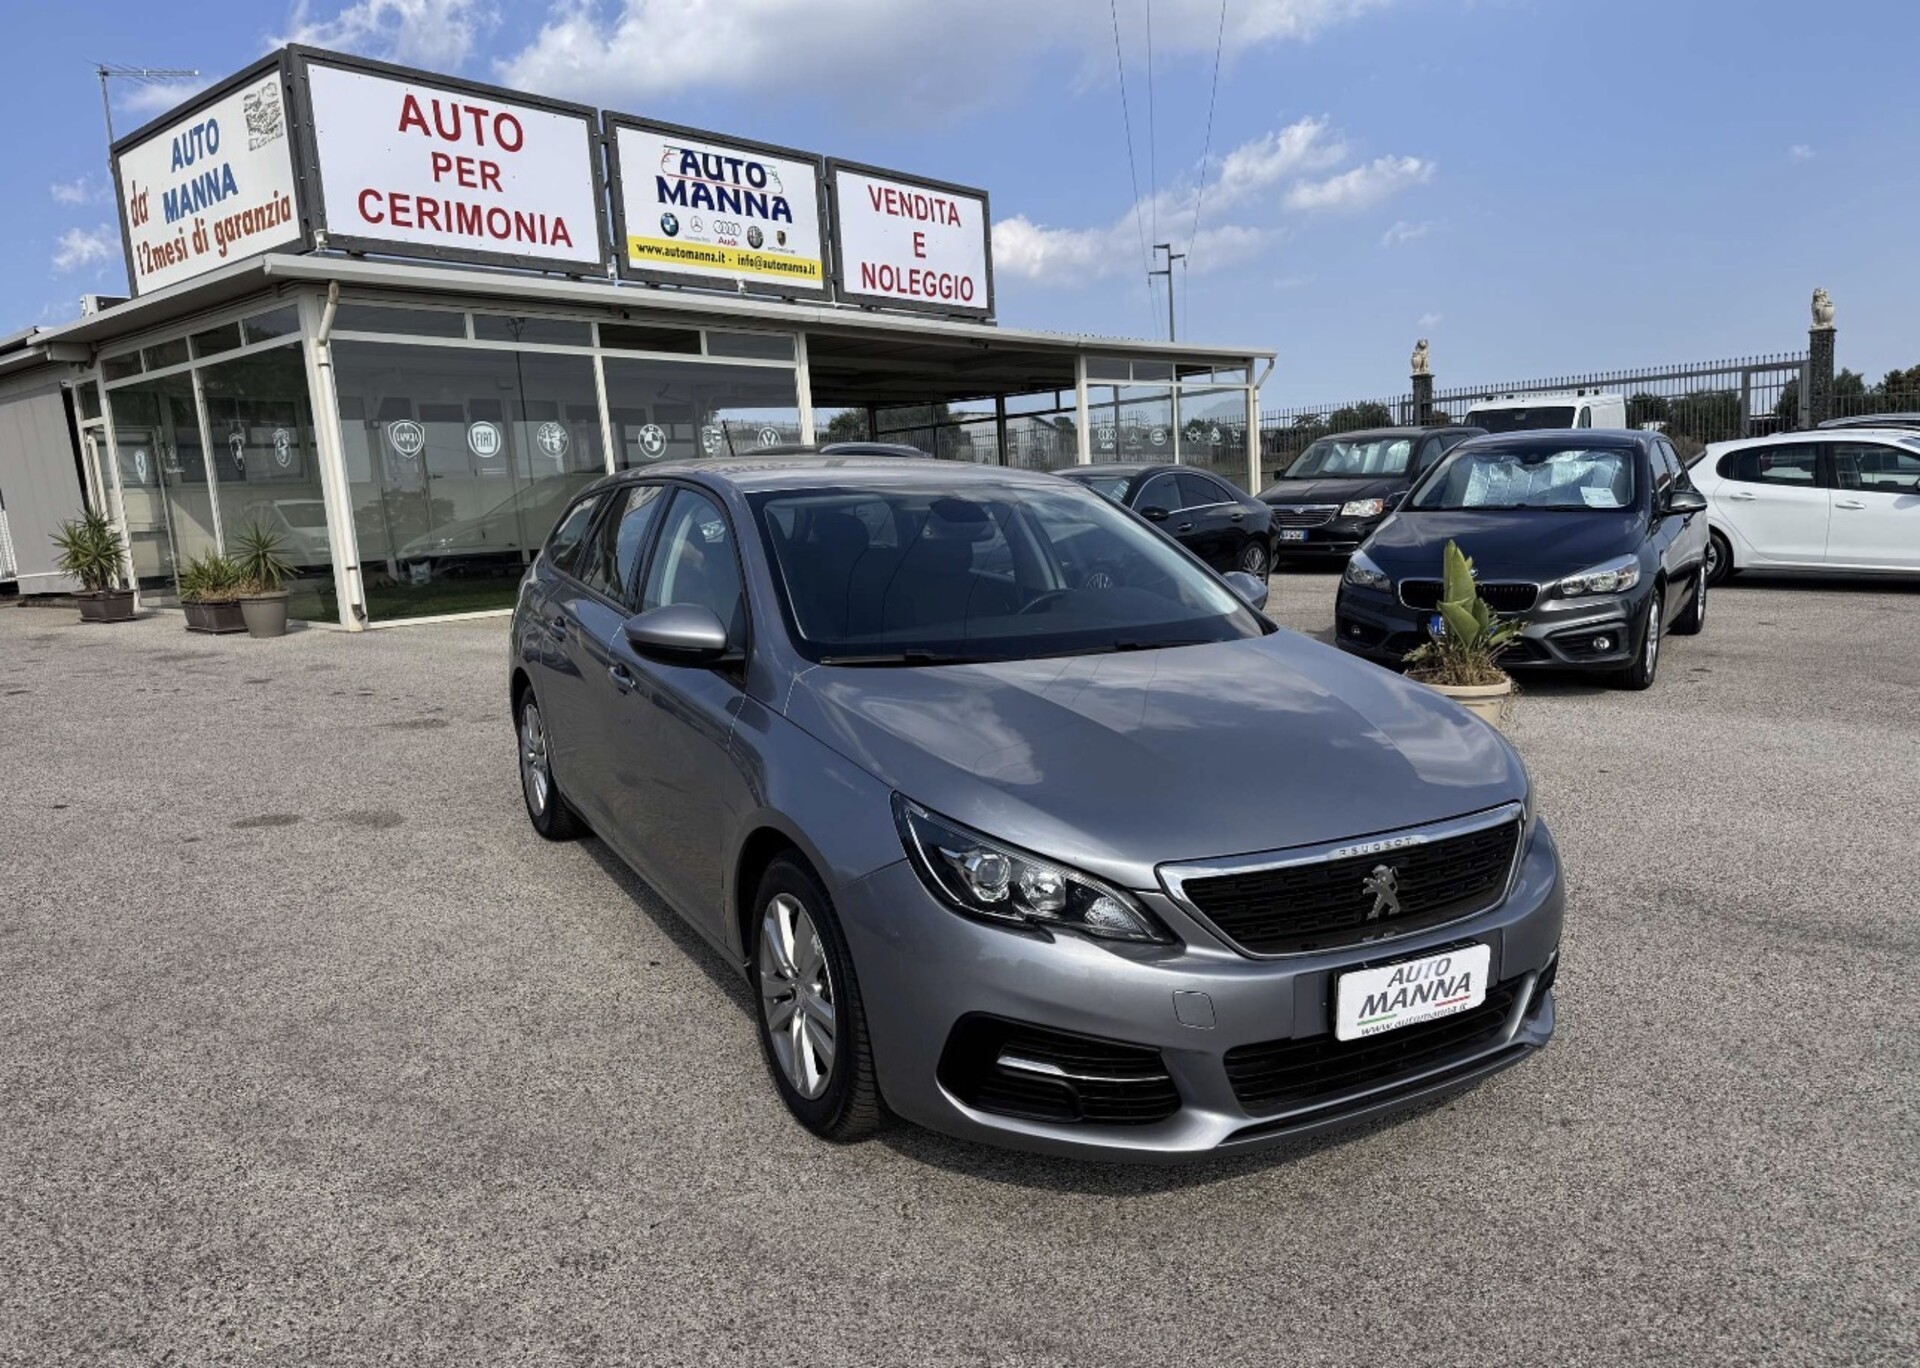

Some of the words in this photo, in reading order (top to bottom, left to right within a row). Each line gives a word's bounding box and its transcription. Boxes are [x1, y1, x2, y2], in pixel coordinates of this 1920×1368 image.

[398, 94, 524, 153] AUTO
[171, 118, 219, 173] AUTO
[431, 151, 504, 192] PER
[679, 148, 767, 189] AUTO
[162, 162, 239, 224] MANNA
[655, 175, 793, 224] MANNA
[867, 184, 962, 228] VENDITA
[192, 217, 210, 255] di
[214, 190, 292, 258] garanzia
[358, 188, 573, 248] CERIMONIA
[637, 242, 726, 264] www.automanna.it
[738, 253, 816, 275] info@automanna.it
[717, 236, 739, 247] Audi
[912, 232, 927, 258] E
[861, 262, 974, 302] NOLEGGIO
[475, 431, 493, 447] FIAT
[1387, 957, 1452, 987] AUTO
[1358, 971, 1471, 1019] MANNA
